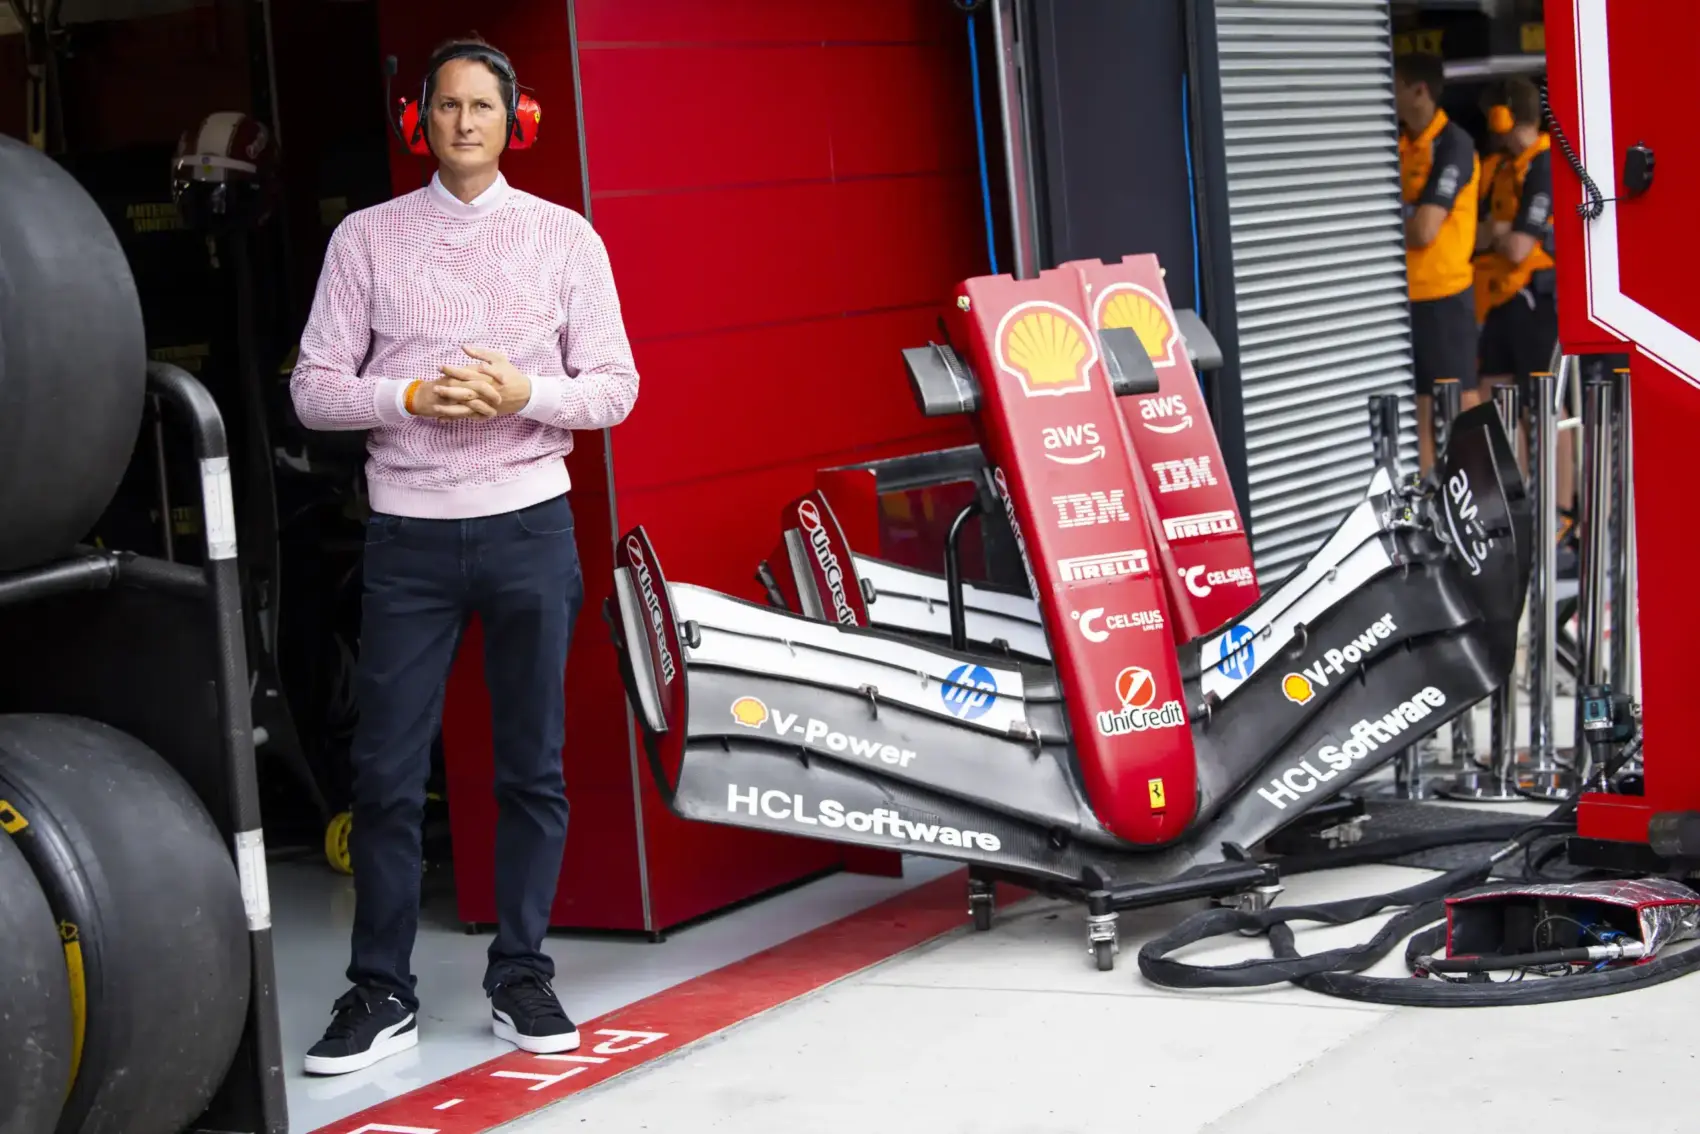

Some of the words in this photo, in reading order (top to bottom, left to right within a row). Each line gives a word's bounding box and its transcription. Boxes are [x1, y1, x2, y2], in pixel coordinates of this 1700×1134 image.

[1139, 395, 1187, 420] aws
[1042, 423, 1100, 449] aws
[1152, 456, 1218, 493] IBM
[1052, 490, 1130, 528] IBM
[1162, 510, 1238, 540] PIRELLI
[1057, 549, 1149, 582] PIRELLI
[638, 565, 676, 685] UniCredit
[1303, 612, 1398, 687] V-Power
[1097, 701, 1184, 735] UniCredit
[771, 709, 916, 767] V-Power
[1257, 686, 1446, 809] HCLSoftware
[727, 783, 1001, 851] HCLSoftware
[490, 1029, 669, 1090] PIT
